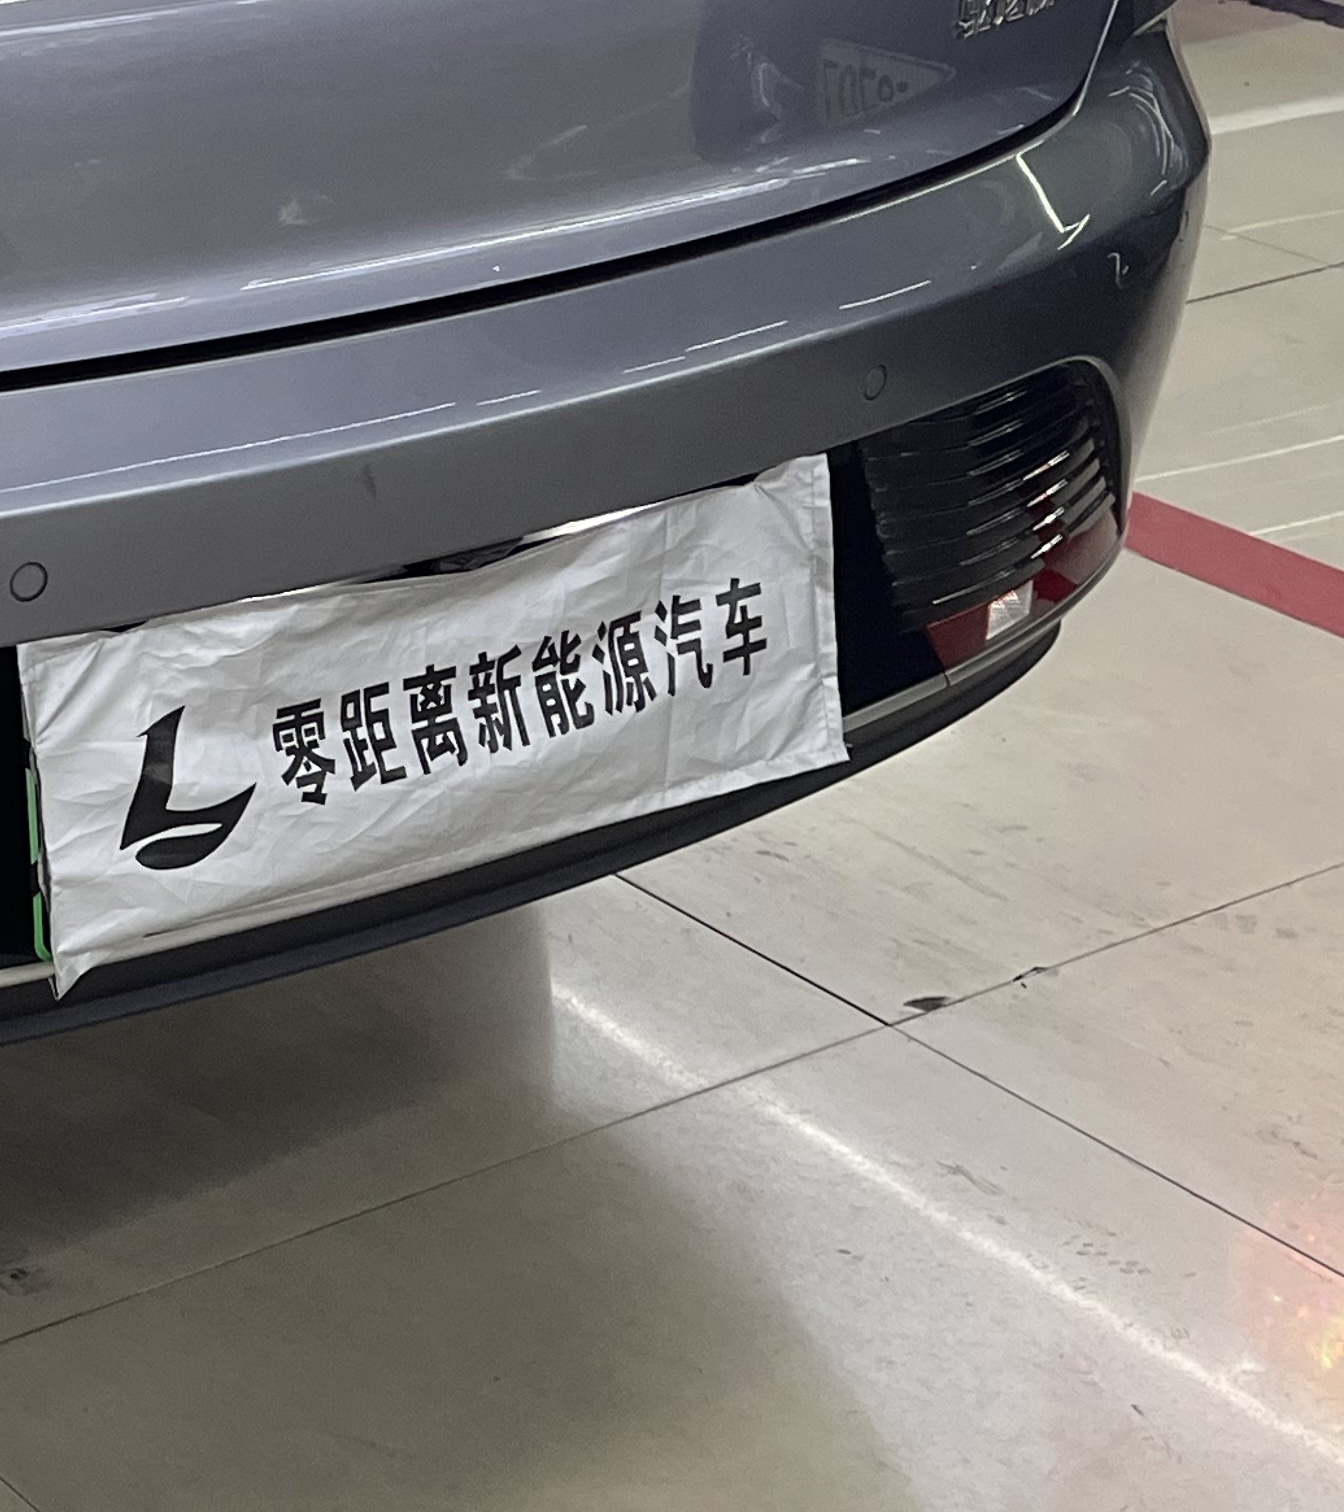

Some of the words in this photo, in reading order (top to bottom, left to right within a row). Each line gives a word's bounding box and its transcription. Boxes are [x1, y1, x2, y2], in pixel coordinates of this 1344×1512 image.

[271, 576, 768, 806] 零距离新能源汽车
